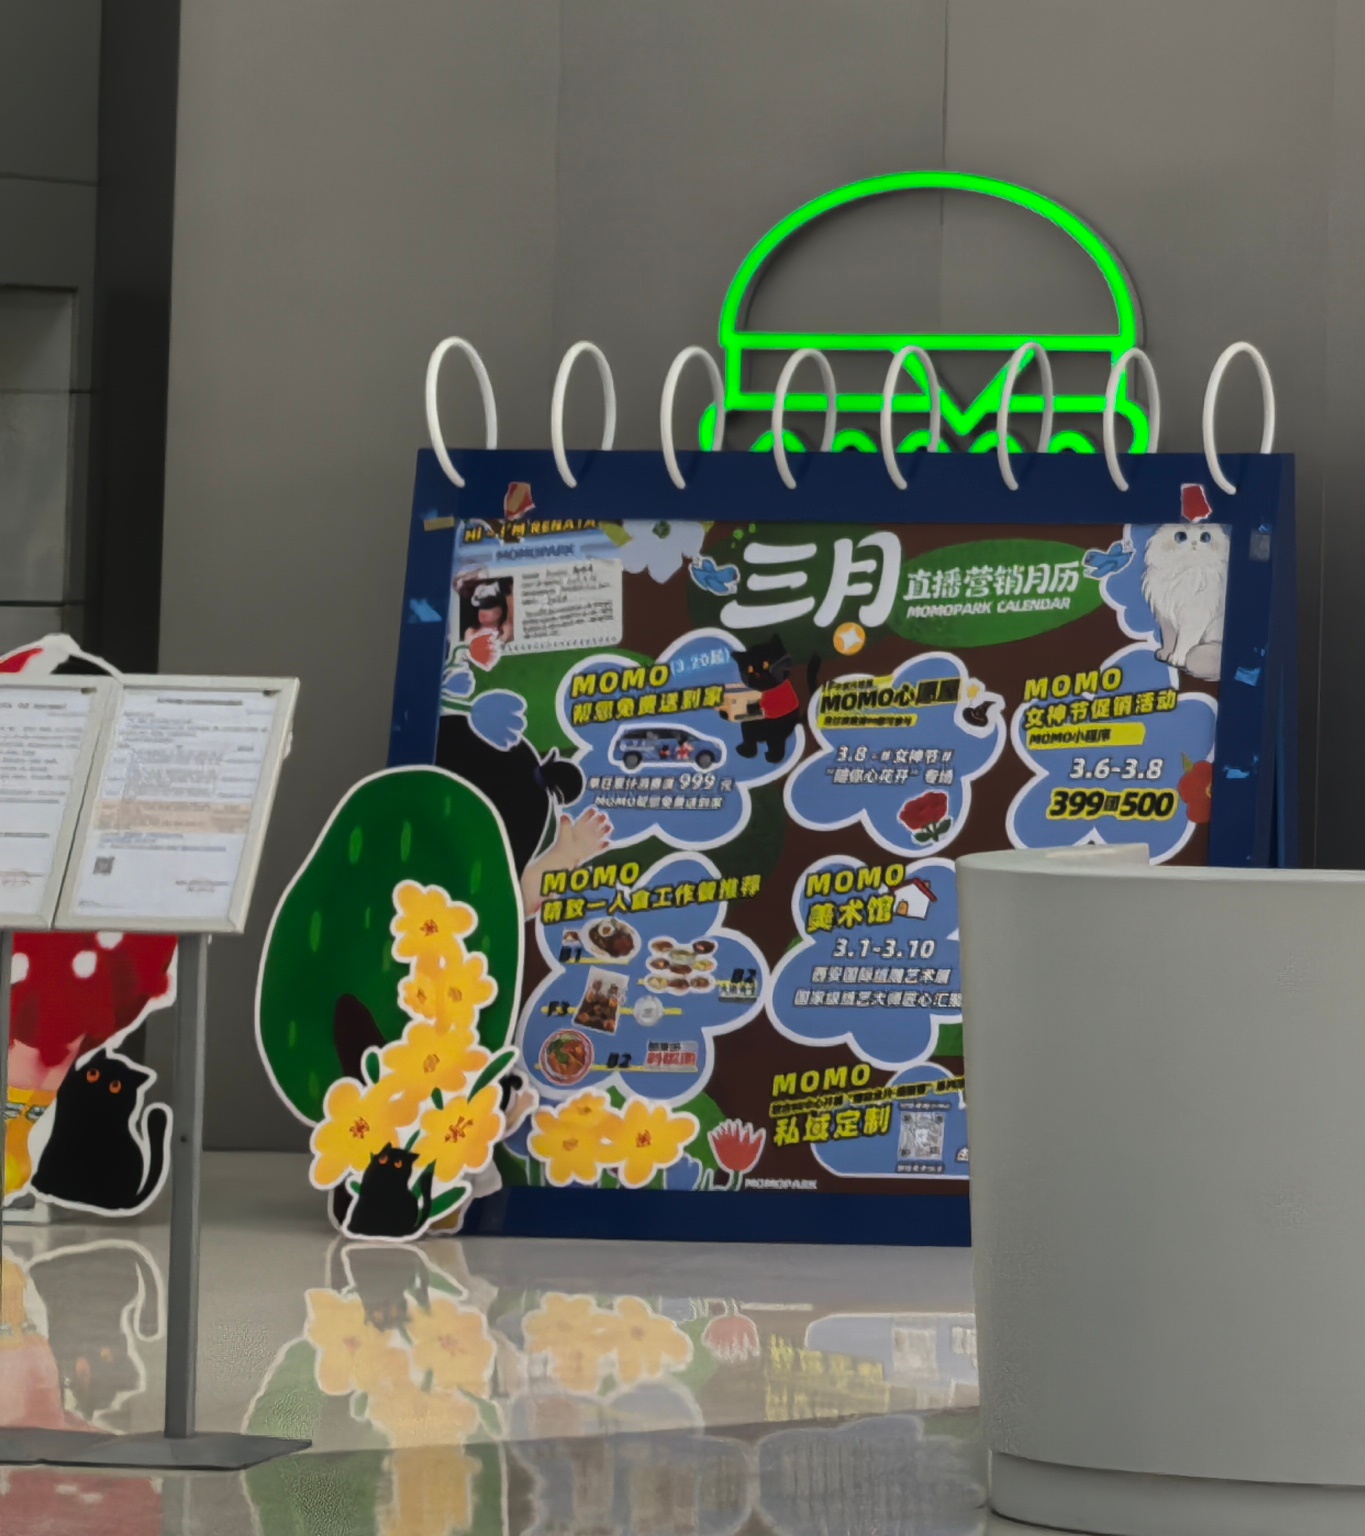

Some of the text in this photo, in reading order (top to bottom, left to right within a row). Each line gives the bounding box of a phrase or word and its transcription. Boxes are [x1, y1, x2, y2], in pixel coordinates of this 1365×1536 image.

[720, 531, 902, 628] 三月
[903, 560, 1080, 601] 直播营销月历
[906, 597, 1072, 619] MOMOPARK CALENDAR
[571, 665, 669, 697] MOMO
[1024, 667, 1122, 701] MOMO
[1025, 689, 1177, 729] 女神节促销活动
[679, 772, 717, 790] 999
[1070, 757, 1164, 779] 3.6-3.8
[542, 861, 640, 895] MOMO
[806, 863, 905, 897] MOMO
[806, 894, 895, 933] 美术馆
[833, 937, 937, 959] 3.1-3.10
[772, 1064, 870, 1096] MOMO
